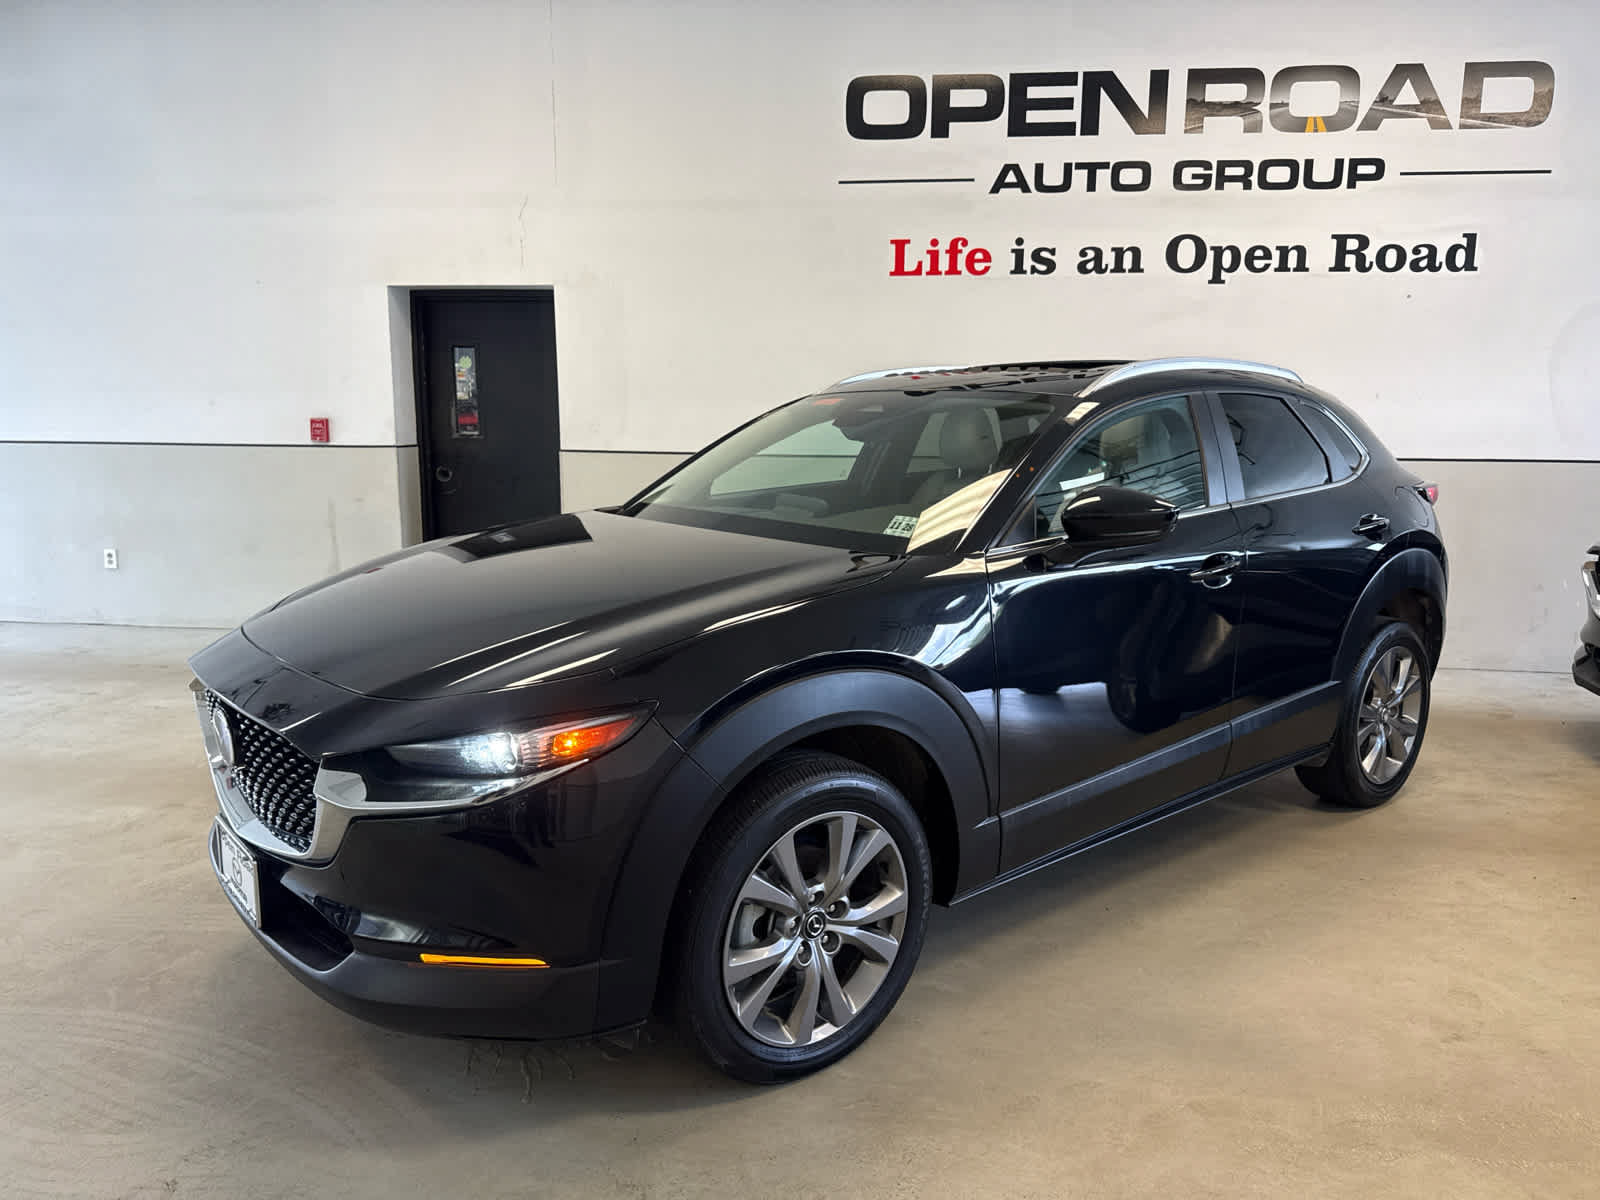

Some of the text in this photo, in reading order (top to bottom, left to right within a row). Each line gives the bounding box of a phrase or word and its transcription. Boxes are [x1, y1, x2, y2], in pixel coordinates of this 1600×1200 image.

[845, 60, 1555, 141] OPEN ROAD
[989, 158, 1386, 194] AUTO GROUP
[889, 233, 1479, 285] Life is an Open Road
